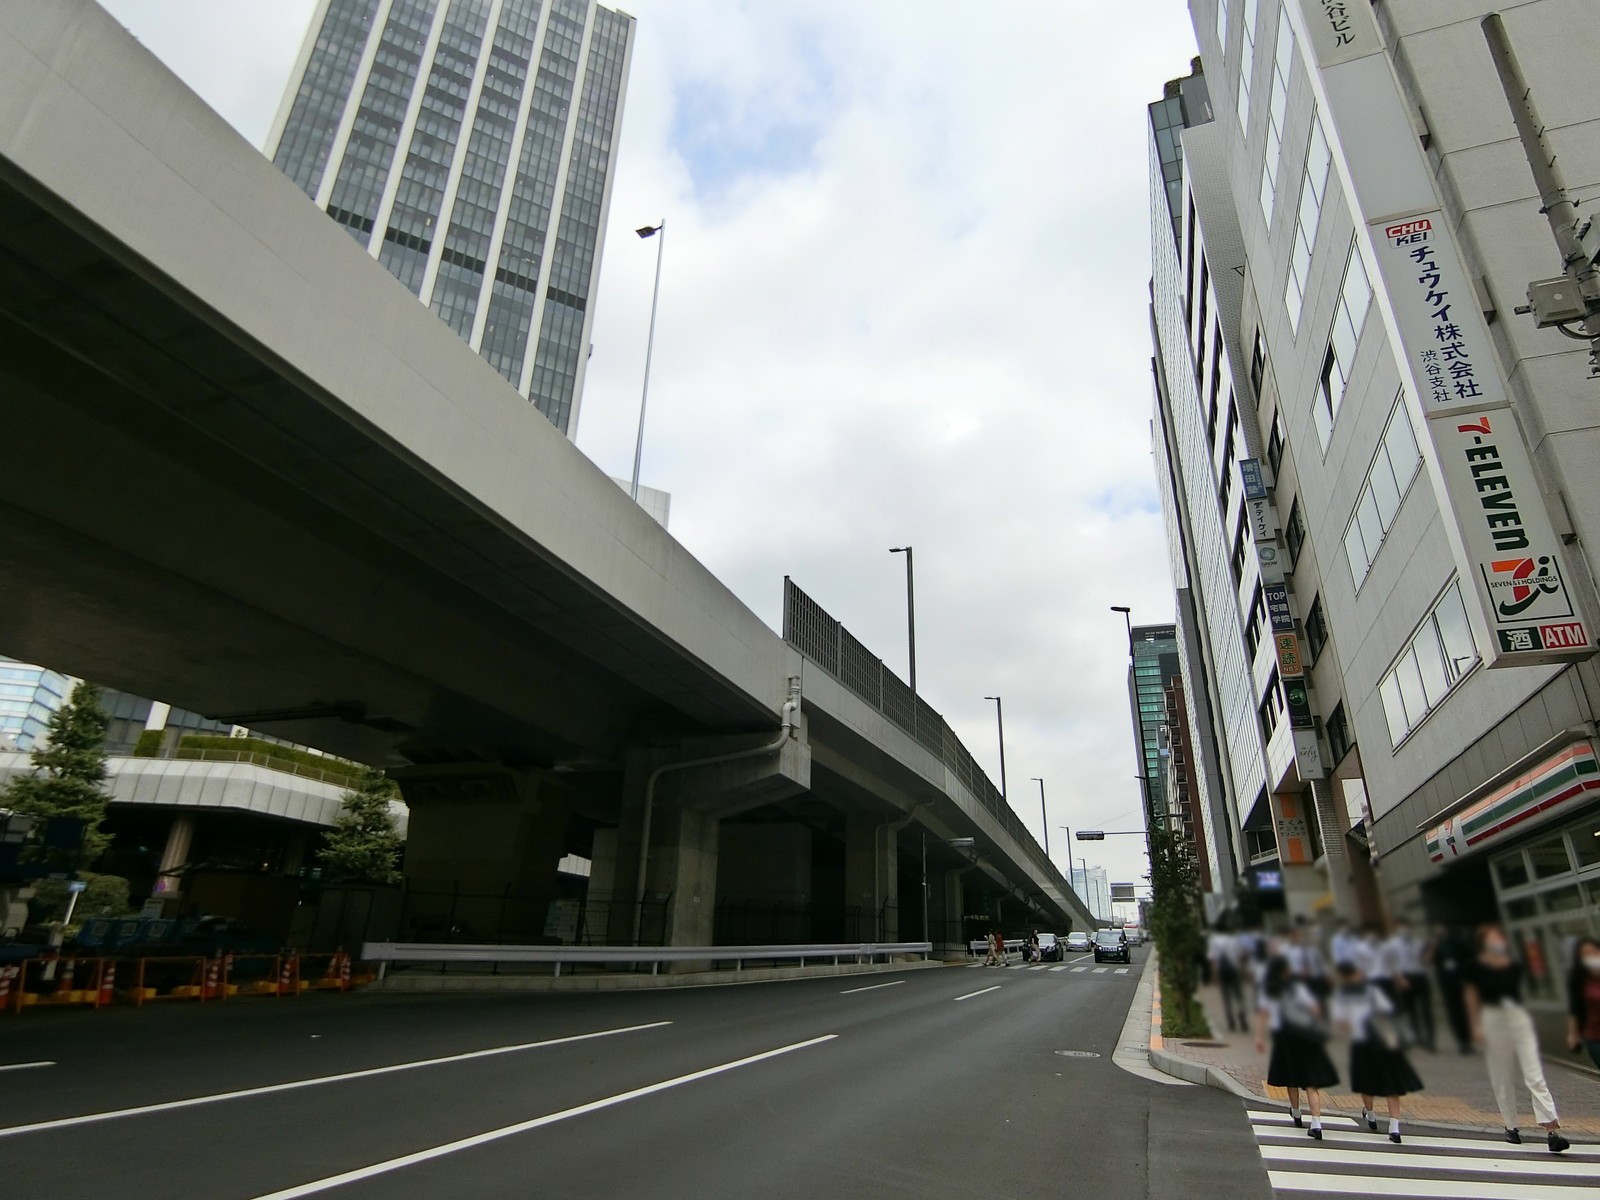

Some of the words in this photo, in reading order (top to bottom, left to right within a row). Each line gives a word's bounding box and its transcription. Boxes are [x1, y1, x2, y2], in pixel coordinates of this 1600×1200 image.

[1321, 0, 1356, 48] 谷ビル
[1388, 219, 1428, 238] CHU
[1396, 232, 1428, 246] KEI
[1409, 246, 1483, 399] チュウケイ株式会社
[1420, 350, 1452, 402] 渋谷支社
[1521, 575, 1558, 585] HOLDINGS
[1267, 591, 1286, 601] TOP
[1506, 629, 1534, 651] 酒
[1545, 625, 1586, 648] ATM
[1280, 637, 1297, 665] 速読
